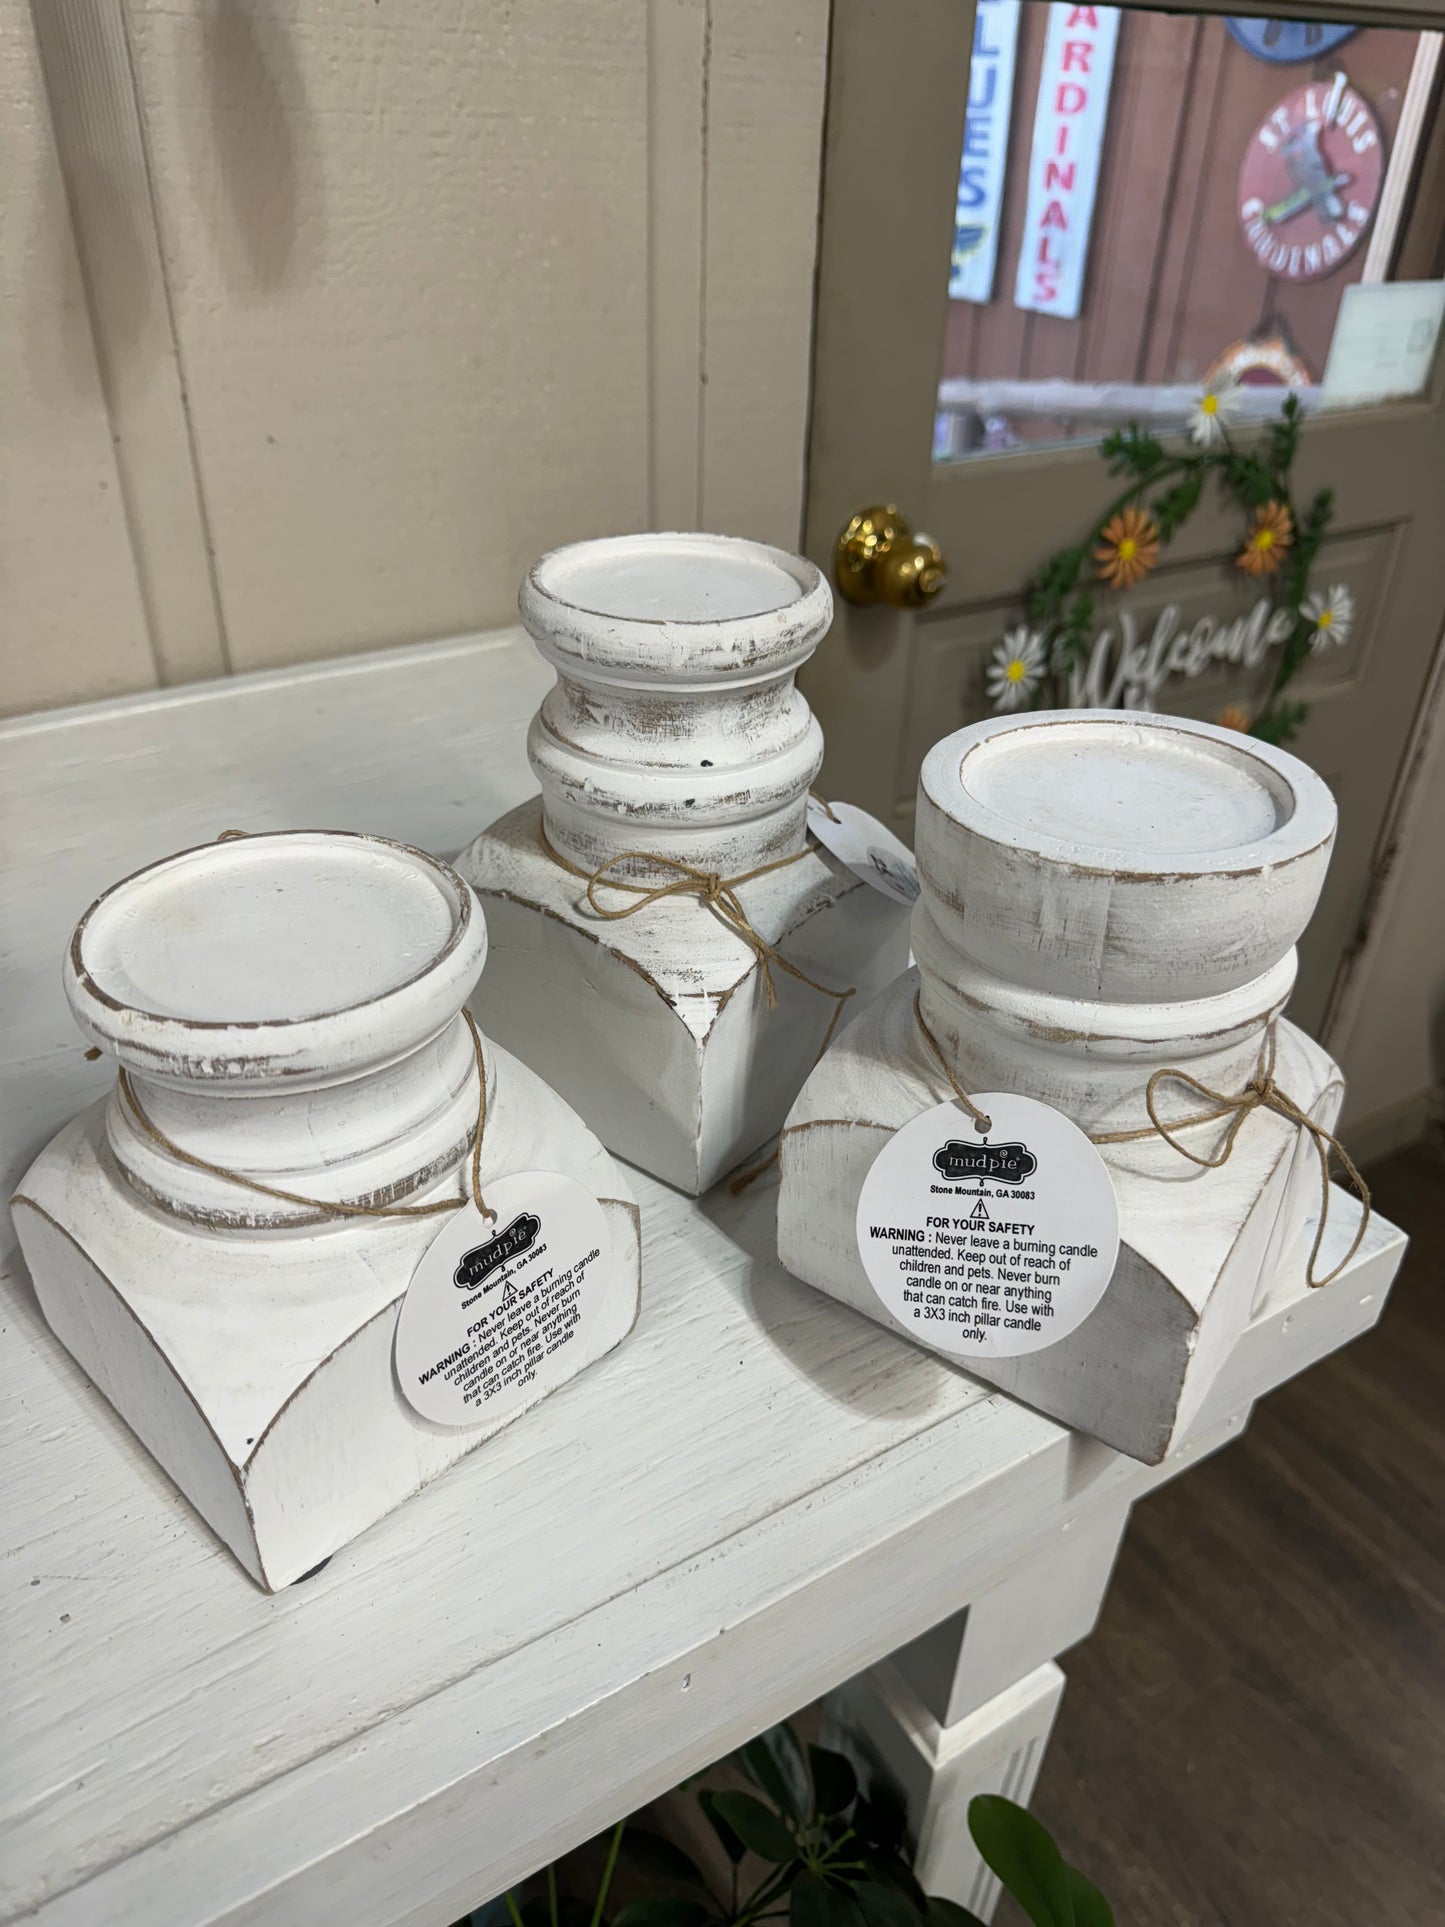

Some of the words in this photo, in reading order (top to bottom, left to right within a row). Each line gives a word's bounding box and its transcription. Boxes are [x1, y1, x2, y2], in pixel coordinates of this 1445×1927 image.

[958, 0, 1000, 208] LUES
[930, 1184, 953, 1194] Stone
[955, 1186, 994, 1198] Mountain,
[996, 1189, 1009, 1198] GA
[1011, 1190, 1035, 1200] 30083
[870, 1226, 925, 1242] WARNING
[935, 1231, 967, 1246] Never
[970, 1235, 1000, 1249] leave
[1002, 1240, 1010, 1250] a
[1013, 1238, 1056, 1257] burning
[1058, 1244, 1098, 1258] candle
[926, 1216, 950, 1229] FOR
[952, 1218, 985, 1232] YOUR
[988, 1221, 1035, 1236] SAFETY
[892, 1245, 954, 1260] unattended.
[957, 1248, 986, 1265] Keep
[989, 1253, 1006, 1265] out
[1009, 1254, 1021, 1266] of
[1024, 1257, 1056, 1269] reach
[1059, 1258, 1071, 1271] of
[899, 1259, 941, 1274] children
[944, 1264, 964, 1276] and
[967, 1267, 994, 1280] pets.
[998, 1267, 1031, 1283] Never
[1034, 1271, 1060, 1286] burn
[461, 1292, 482, 1309] Stone
[483, 1269, 516, 1294] Mountain,
[516, 1259, 528, 1269] GA
[528, 1243, 547, 1262] 30083
[906, 1276, 942, 1289] candle
[944, 1280, 958, 1291] on
[961, 1282, 972, 1292] or
[975, 1283, 1001, 1295] near
[1003, 1286, 1052, 1303] anything
[418, 1343, 470, 1385] WARNING
[478, 1318, 505, 1343] Never
[507, 1300, 532, 1322] leave
[540, 1269, 572, 1297] burning
[573, 1248, 600, 1273] candle
[467, 1317, 488, 1337] FOR
[489, 1295, 518, 1320] YOUR
[518, 1267, 553, 1300] SAFETY
[903, 1289, 923, 1303] that
[925, 1293, 945, 1305] can
[948, 1295, 978, 1308] catch
[981, 1296, 1001, 1311] fire.
[1005, 1299, 1028, 1314] Use
[1031, 1303, 1054, 1317] with
[444, 1336, 498, 1381] unattended.
[500, 1319, 524, 1340] Keep
[525, 1308, 540, 1322] out
[540, 1297, 550, 1310] of
[551, 1281, 575, 1303] reach
[576, 1270, 585, 1284] of
[913, 1308, 920, 1318] a
[924, 1306, 945, 1320] 3X3
[948, 1309, 971, 1323] inch
[974, 1312, 1001, 1327] pillar
[1003, 1318, 1041, 1331] candle
[454, 1355, 491, 1386] children
[492, 1339, 510, 1359] and
[511, 1326, 532, 1346] pets.
[534, 1303, 560, 1327] Never
[561, 1288, 581, 1308] burn
[463, 1365, 494, 1392] candle
[495, 1355, 507, 1368] on
[509, 1347, 518, 1359] or
[520, 1331, 540, 1350] near
[542, 1303, 577, 1335] anything
[962, 1327, 987, 1343] only.
[463, 1385, 481, 1404] that
[482, 1373, 500, 1389] can
[501, 1354, 525, 1376] catch
[527, 1342, 543, 1357] fire.
[544, 1327, 563, 1344] Use
[563, 1313, 581, 1330] with
[483, 1381, 502, 1400] 3X3
[503, 1368, 522, 1386] inch
[524, 1352, 544, 1373] pillar
[546, 1330, 574, 1355] candle
[517, 1369, 538, 1387] only.
